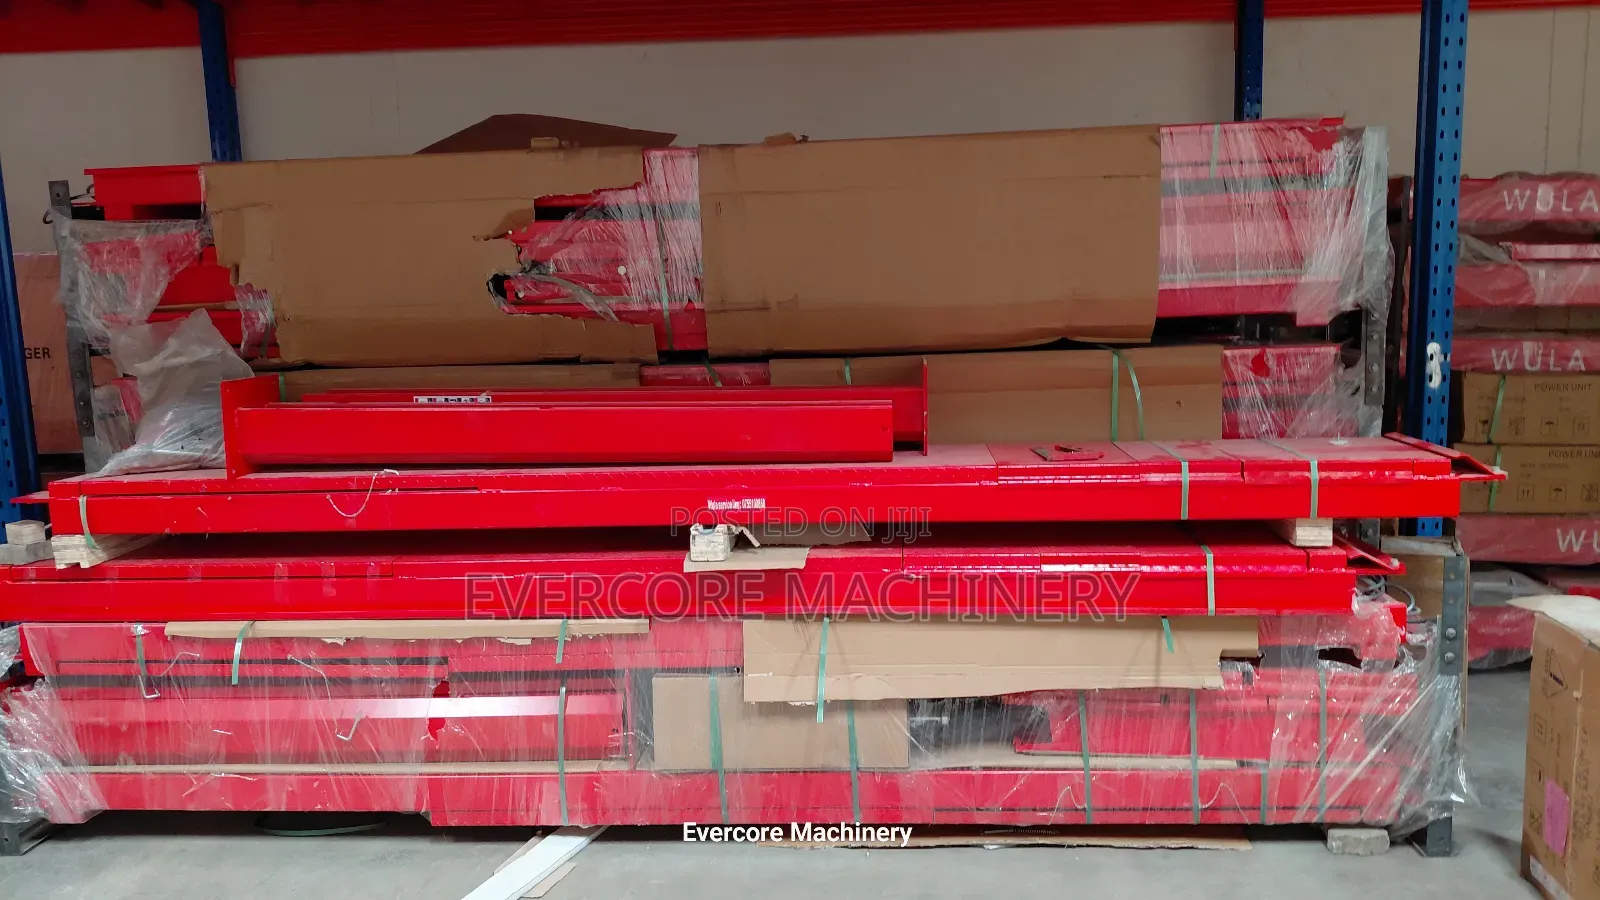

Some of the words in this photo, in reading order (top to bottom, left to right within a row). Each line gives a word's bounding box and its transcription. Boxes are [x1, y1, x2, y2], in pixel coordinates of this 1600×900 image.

[1503, 188, 1600, 212] WULA
[1491, 347, 1586, 372] WULA
[1534, 383, 1569, 392] POWER
[1571, 383, 1593, 392] UNIT
[1549, 450, 1583, 459] POWER
